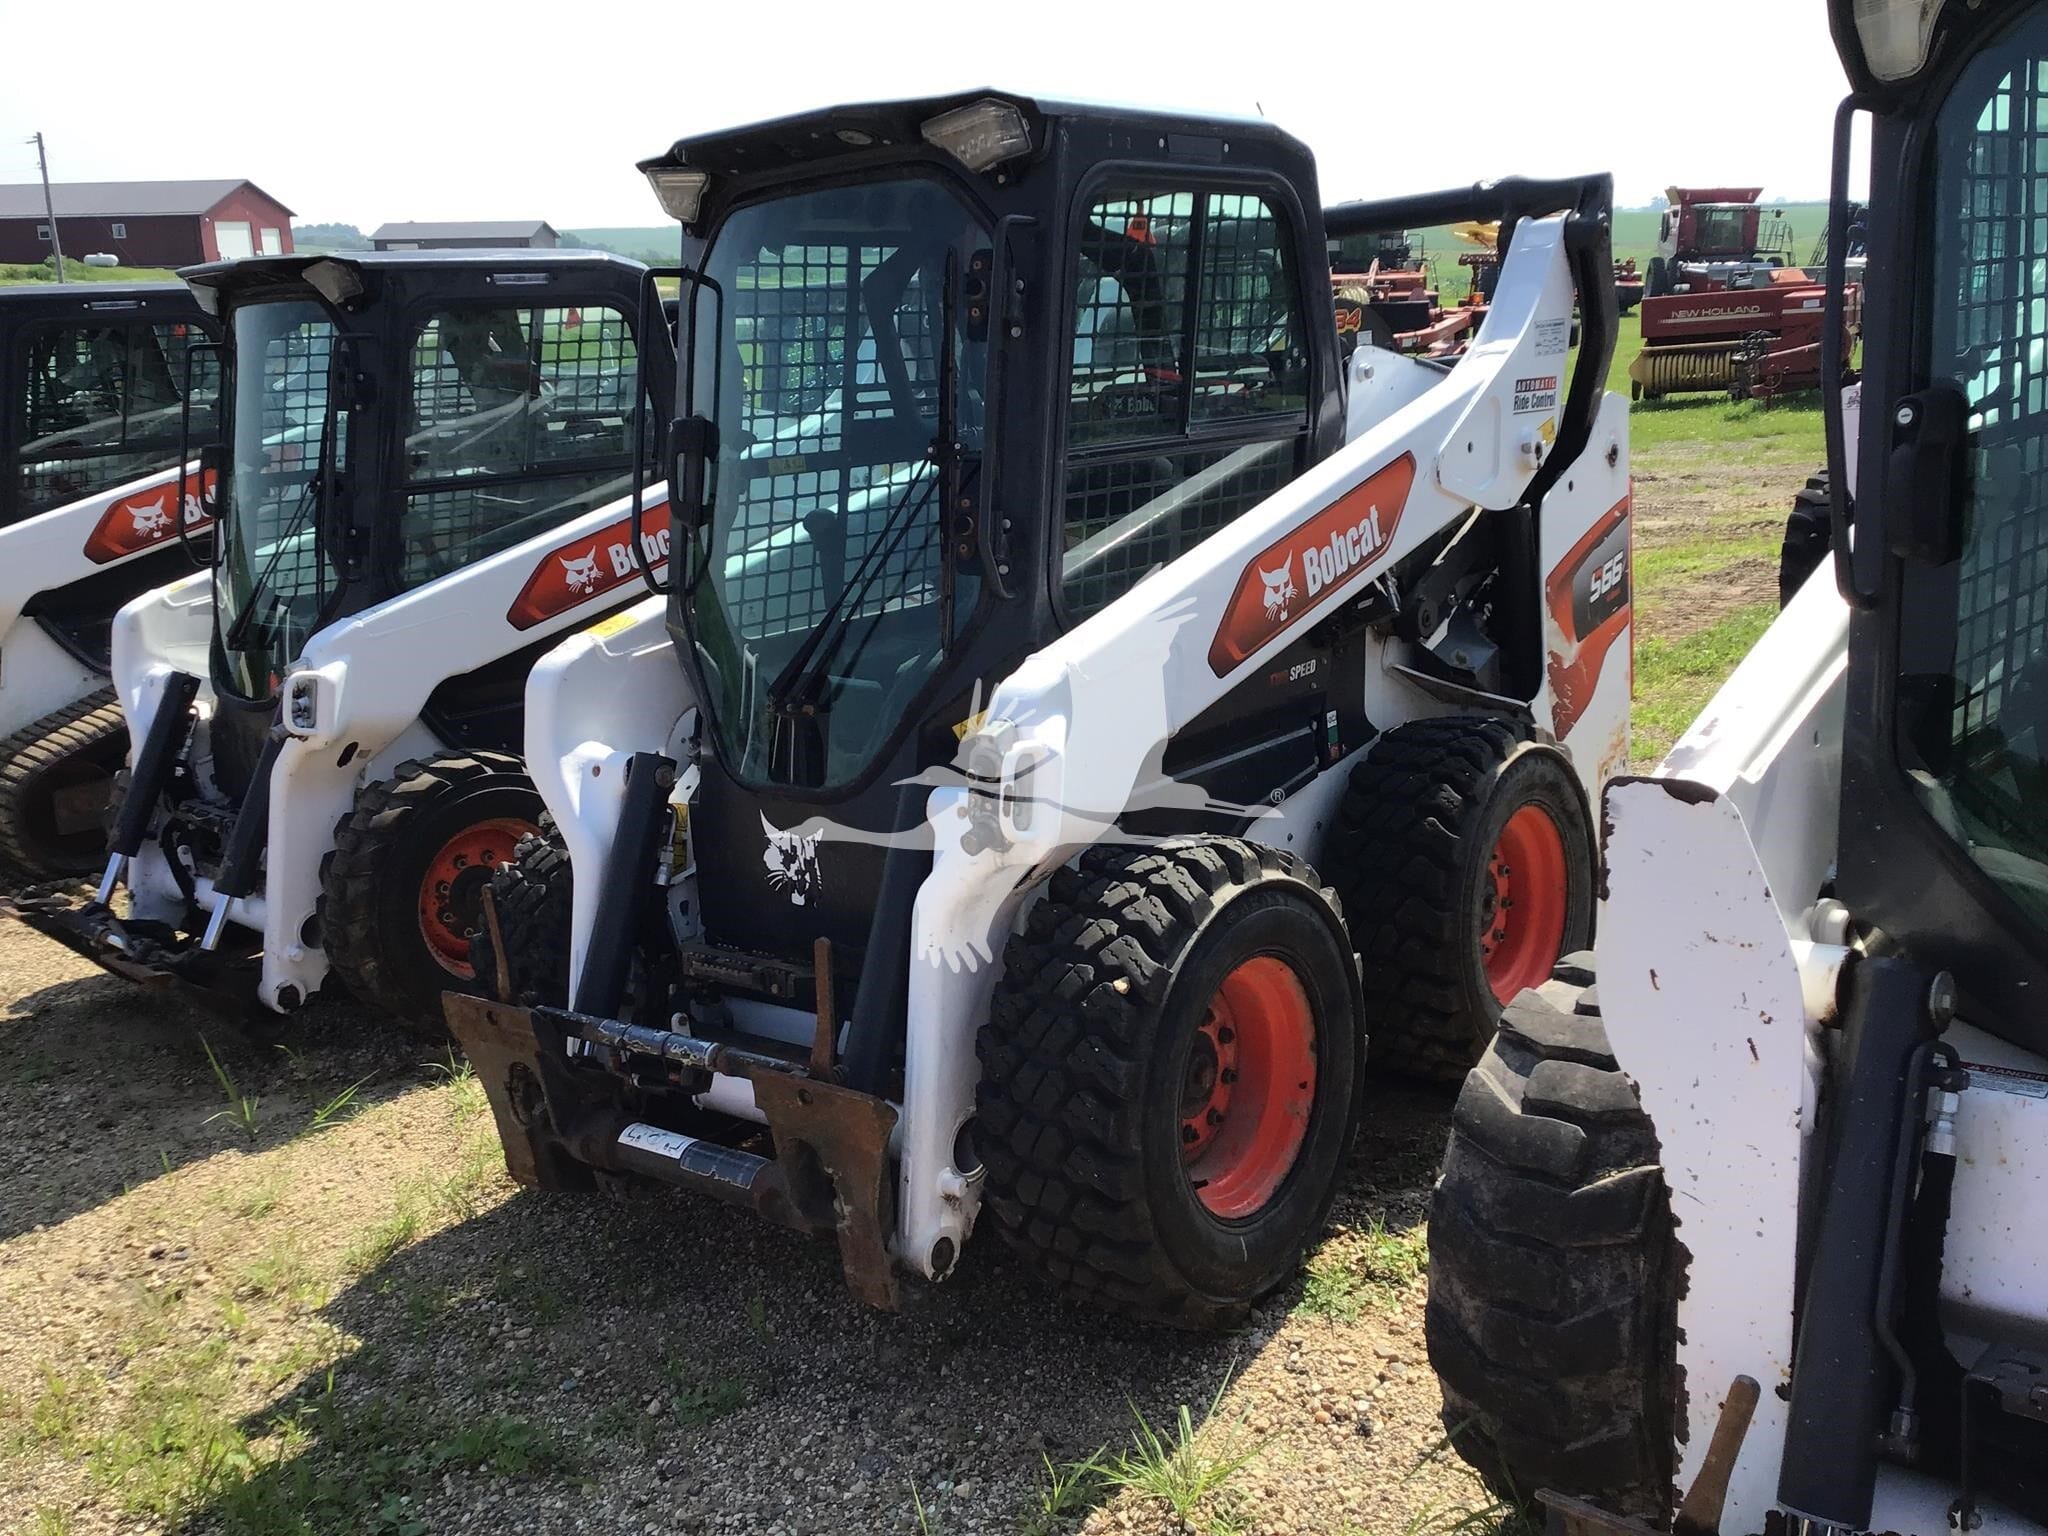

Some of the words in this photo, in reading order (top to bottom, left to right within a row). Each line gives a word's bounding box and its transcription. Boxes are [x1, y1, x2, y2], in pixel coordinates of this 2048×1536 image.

[1671, 309, 1700, 318] NEW
[1702, 305, 1761, 316] HOLLAND
[1516, 378, 1556, 392] AUTOMATIC
[1513, 394, 1530, 411] Ride
[1531, 391, 1556, 409] Control
[1302, 504, 1383, 598] Bobcat
[1589, 550, 1624, 604] S66
[1289, 659, 1317, 681] SPEED
[1984, 1066, 2046, 1081] DANGER
